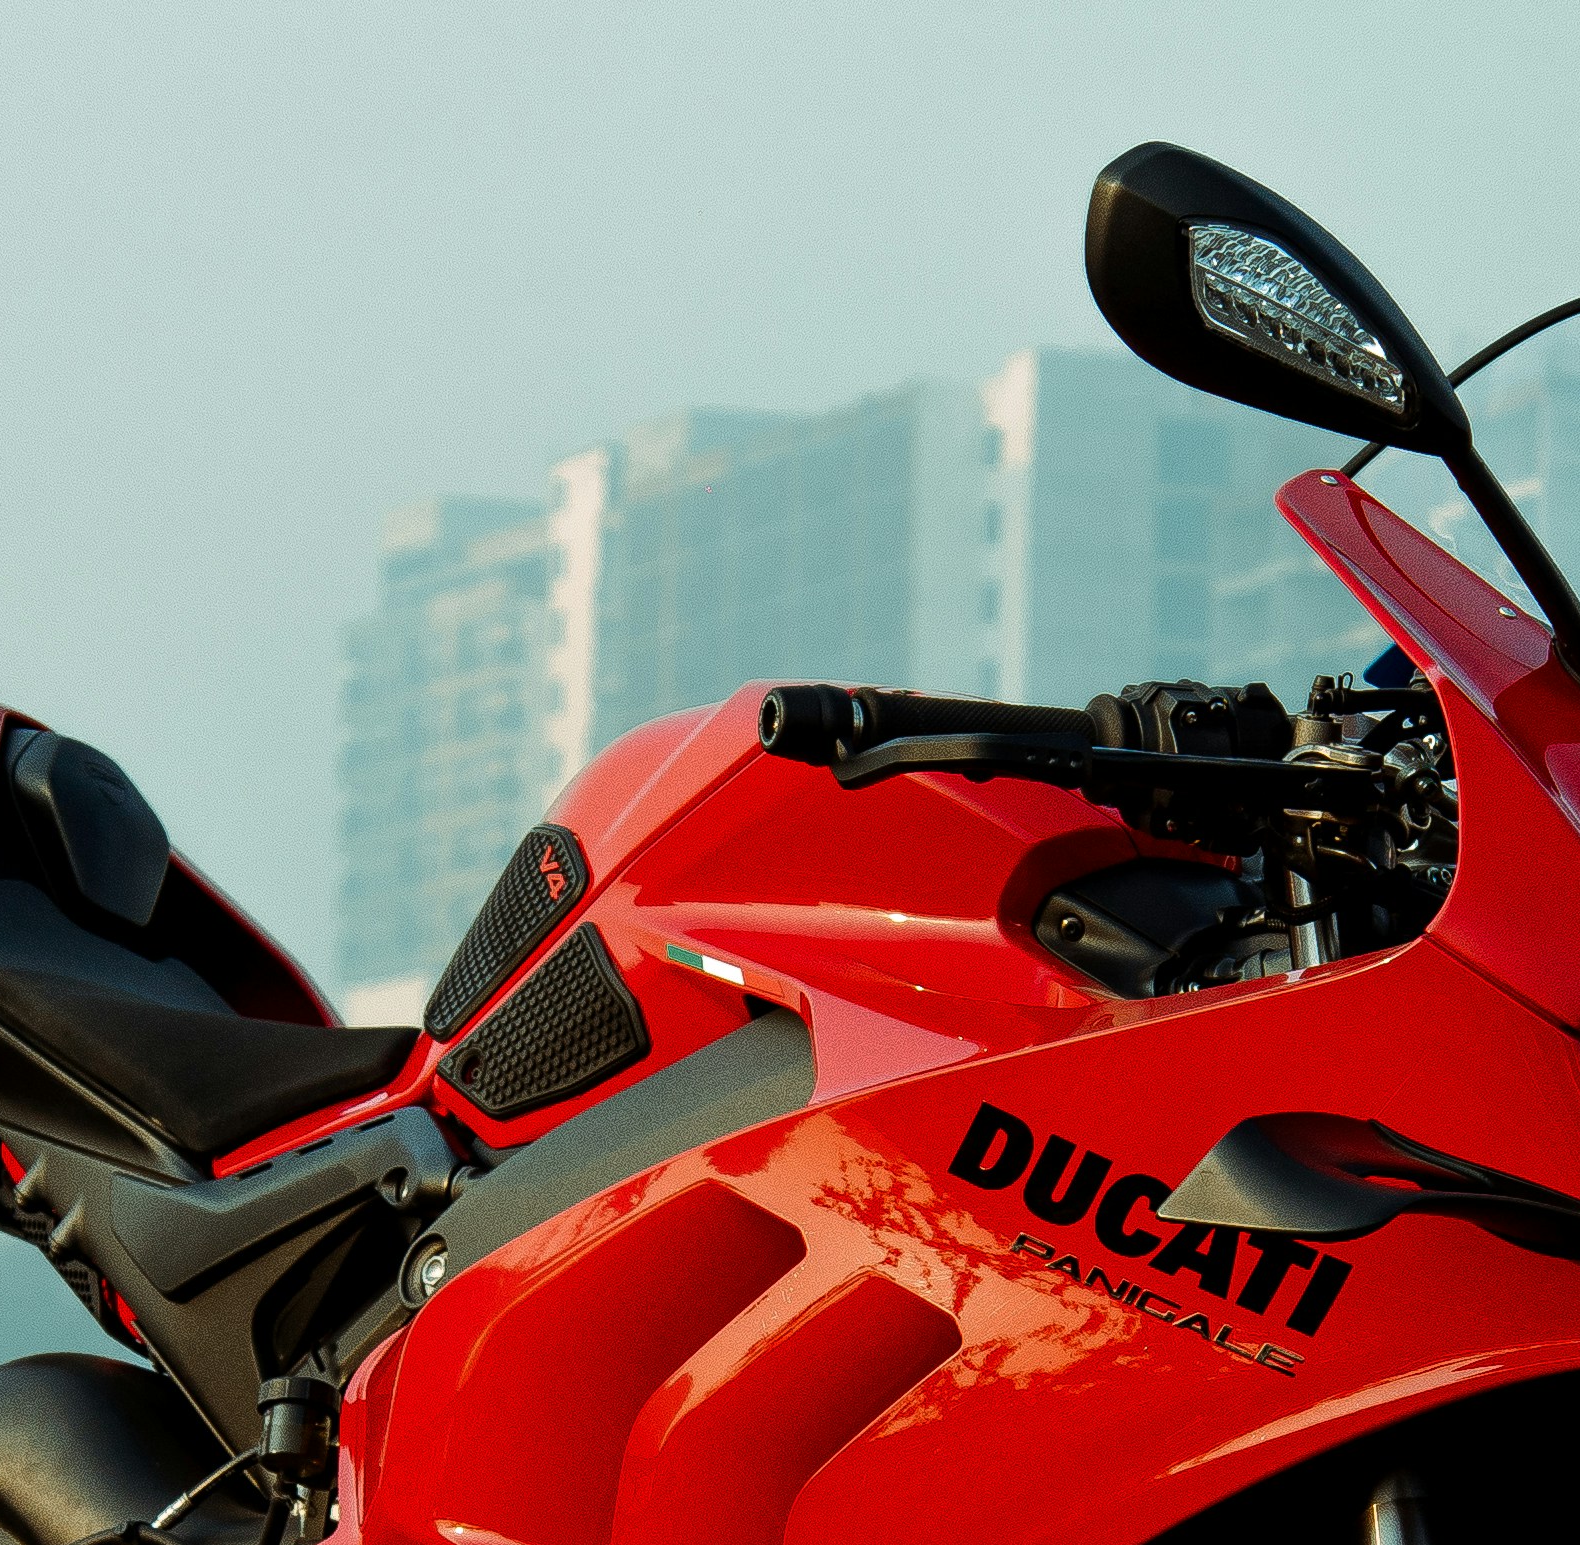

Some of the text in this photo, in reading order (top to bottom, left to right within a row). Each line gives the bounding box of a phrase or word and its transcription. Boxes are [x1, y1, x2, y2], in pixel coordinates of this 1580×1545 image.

[539, 845, 567, 900] V4
[947, 1101, 1353, 1338] DUCATI
[1010, 1231, 1305, 1378] PANIGALE
